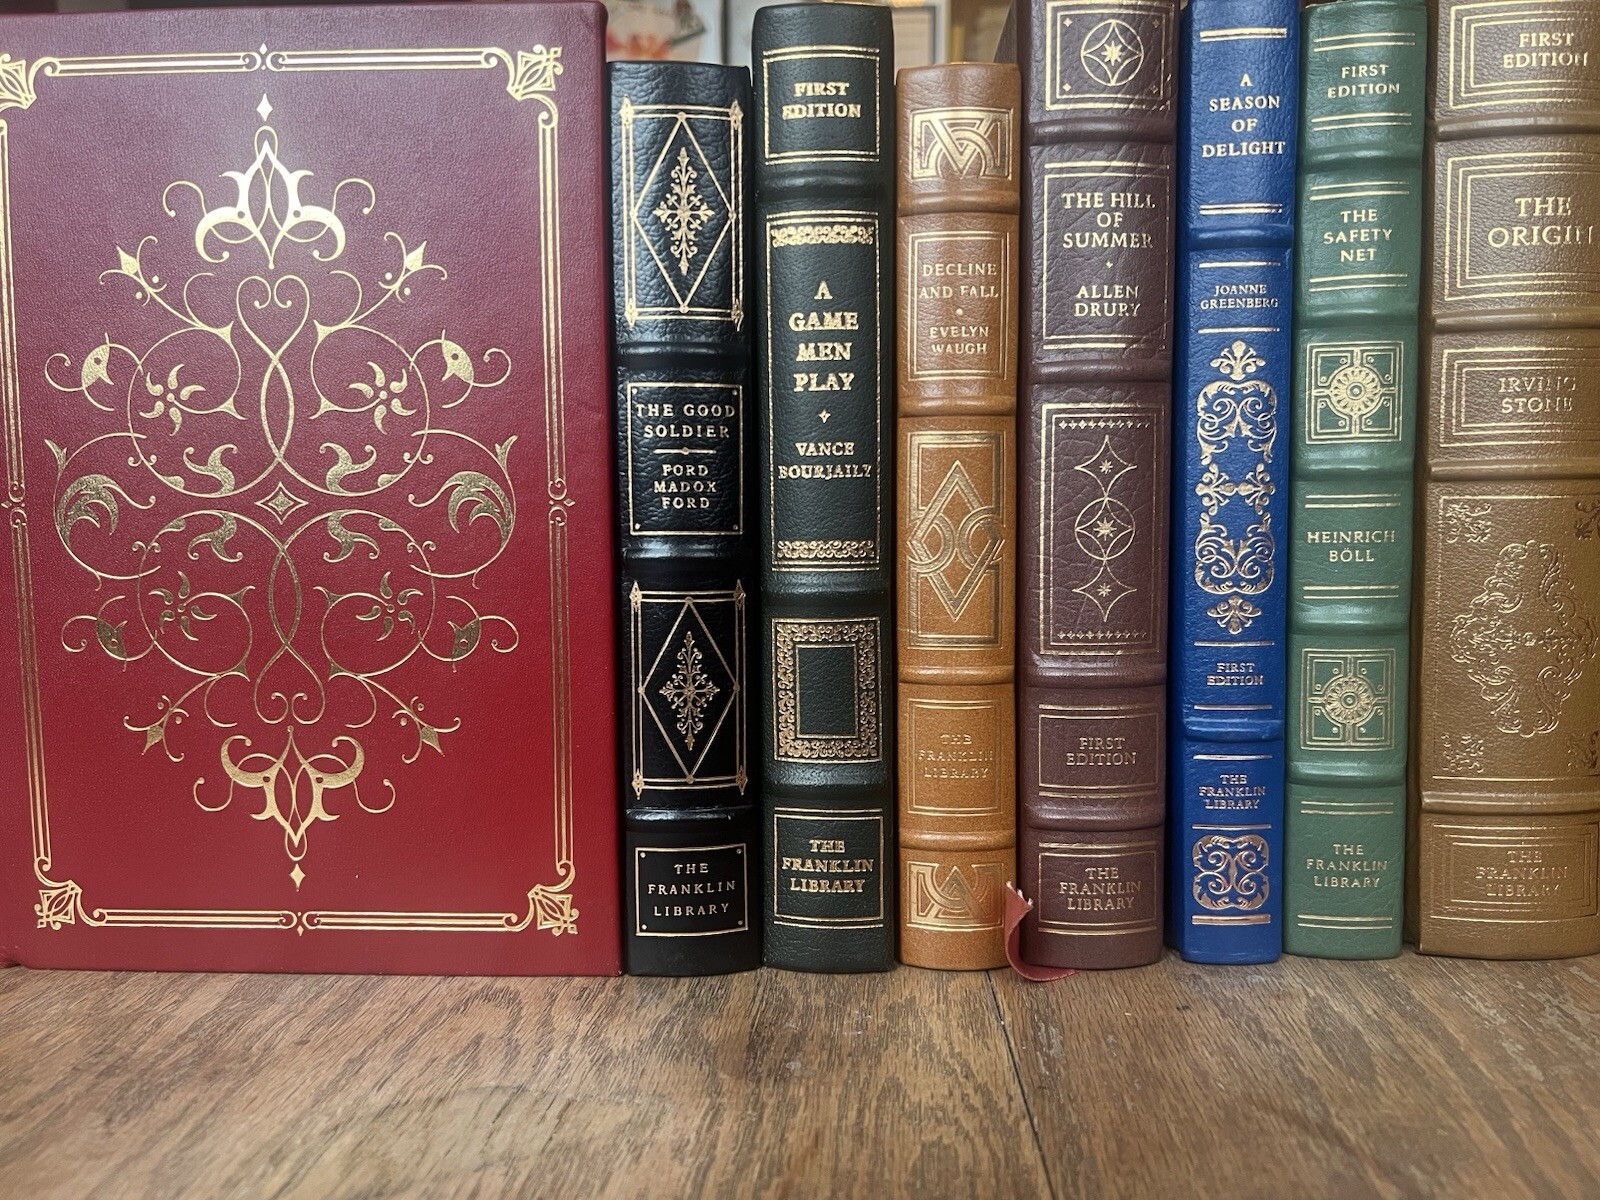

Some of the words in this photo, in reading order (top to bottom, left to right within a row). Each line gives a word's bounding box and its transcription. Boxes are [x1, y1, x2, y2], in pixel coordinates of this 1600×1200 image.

[1519, 32, 1575, 48] FIRST
[1503, 52, 1589, 68] EDITION
[1341, 64, 1389, 79] FIRST
[1240, 73, 1253, 87] A
[793, 82, 850, 97] FIRST
[1327, 83, 1400, 99] EDITION
[1209, 95, 1281, 112] SEASON
[782, 103, 861, 120] EDITION
[1231, 118, 1259, 133] OF
[1201, 141, 1286, 158] DELIGHT
[1061, 192, 1105, 209] THE
[1110, 192, 1156, 209] HILL
[1515, 196, 1572, 217] THE
[1096, 211, 1124, 228] OF
[1340, 209, 1378, 223] THE
[1062, 232, 1154, 249] SUMMER
[1323, 228, 1393, 245] SAFETY
[1488, 225, 1594, 248] ORIGIN
[1340, 248, 1378, 263] NET
[922, 262, 998, 277] DECLINE
[814, 280, 834, 300] A
[919, 286, 953, 299] AND
[960, 285, 999, 299] FALL
[1076, 284, 1139, 299] ALLEN
[1213, 284, 1267, 297] JOANNE
[1074, 302, 1142, 317] DRURY
[1200, 298, 1279, 310] GREENBERG
[788, 312, 859, 331] GAME
[929, 326, 989, 339] EVELYN
[796, 342, 852, 362] MEN
[931, 343, 988, 356] WAUGH
[793, 372, 855, 392] PLAY
[635, 403, 674, 418] THE
[683, 403, 736, 418] GOOD
[643, 425, 730, 439] SOLDIER
[795, 442, 855, 457] VANCE
[662, 464, 709, 477] FORD
[777, 465, 872, 480] BOURJAILY
[653, 481, 717, 493] MADOX
[661, 497, 710, 509] FORD
[1307, 530, 1396, 544] HEINRICH
[1329, 547, 1375, 562] BÖLL
[1216, 662, 1255, 673] FIRST
[1206, 675, 1264, 686] EDITION
[940, 734, 972, 745] THE
[1079, 737, 1126, 750] FIRST
[918, 749, 993, 762] FRANKLIN
[1066, 752, 1137, 767] EDITION
[924, 767, 989, 778] LIBRARY
[1219, 774, 1248, 785] THE
[1198, 786, 1266, 797] FRANKLIN
[1203, 799, 1260, 810] LIBRARY
[809, 838, 846, 854] THE
[1332, 843, 1364, 856] THE
[1507, 850, 1543, 863] THE
[674, 863, 709, 875] THE
[781, 857, 874, 873] FRANKLIN
[1306, 858, 1388, 872] FRANKLIN
[1085, 867, 1119, 880] THE
[1475, 866, 1568, 880] FRANKLIN
[648, 880, 736, 896] FRANKLIN
[790, 878, 866, 893] LIBRARY
[1058, 880, 1142, 895] FRANKLIN
[1313, 876, 1381, 888] LIBRARY
[1486, 884, 1560, 897] LIBRARY
[654, 903, 730, 917] LIBRARY
[1067, 897, 1136, 911] LIBRARY
